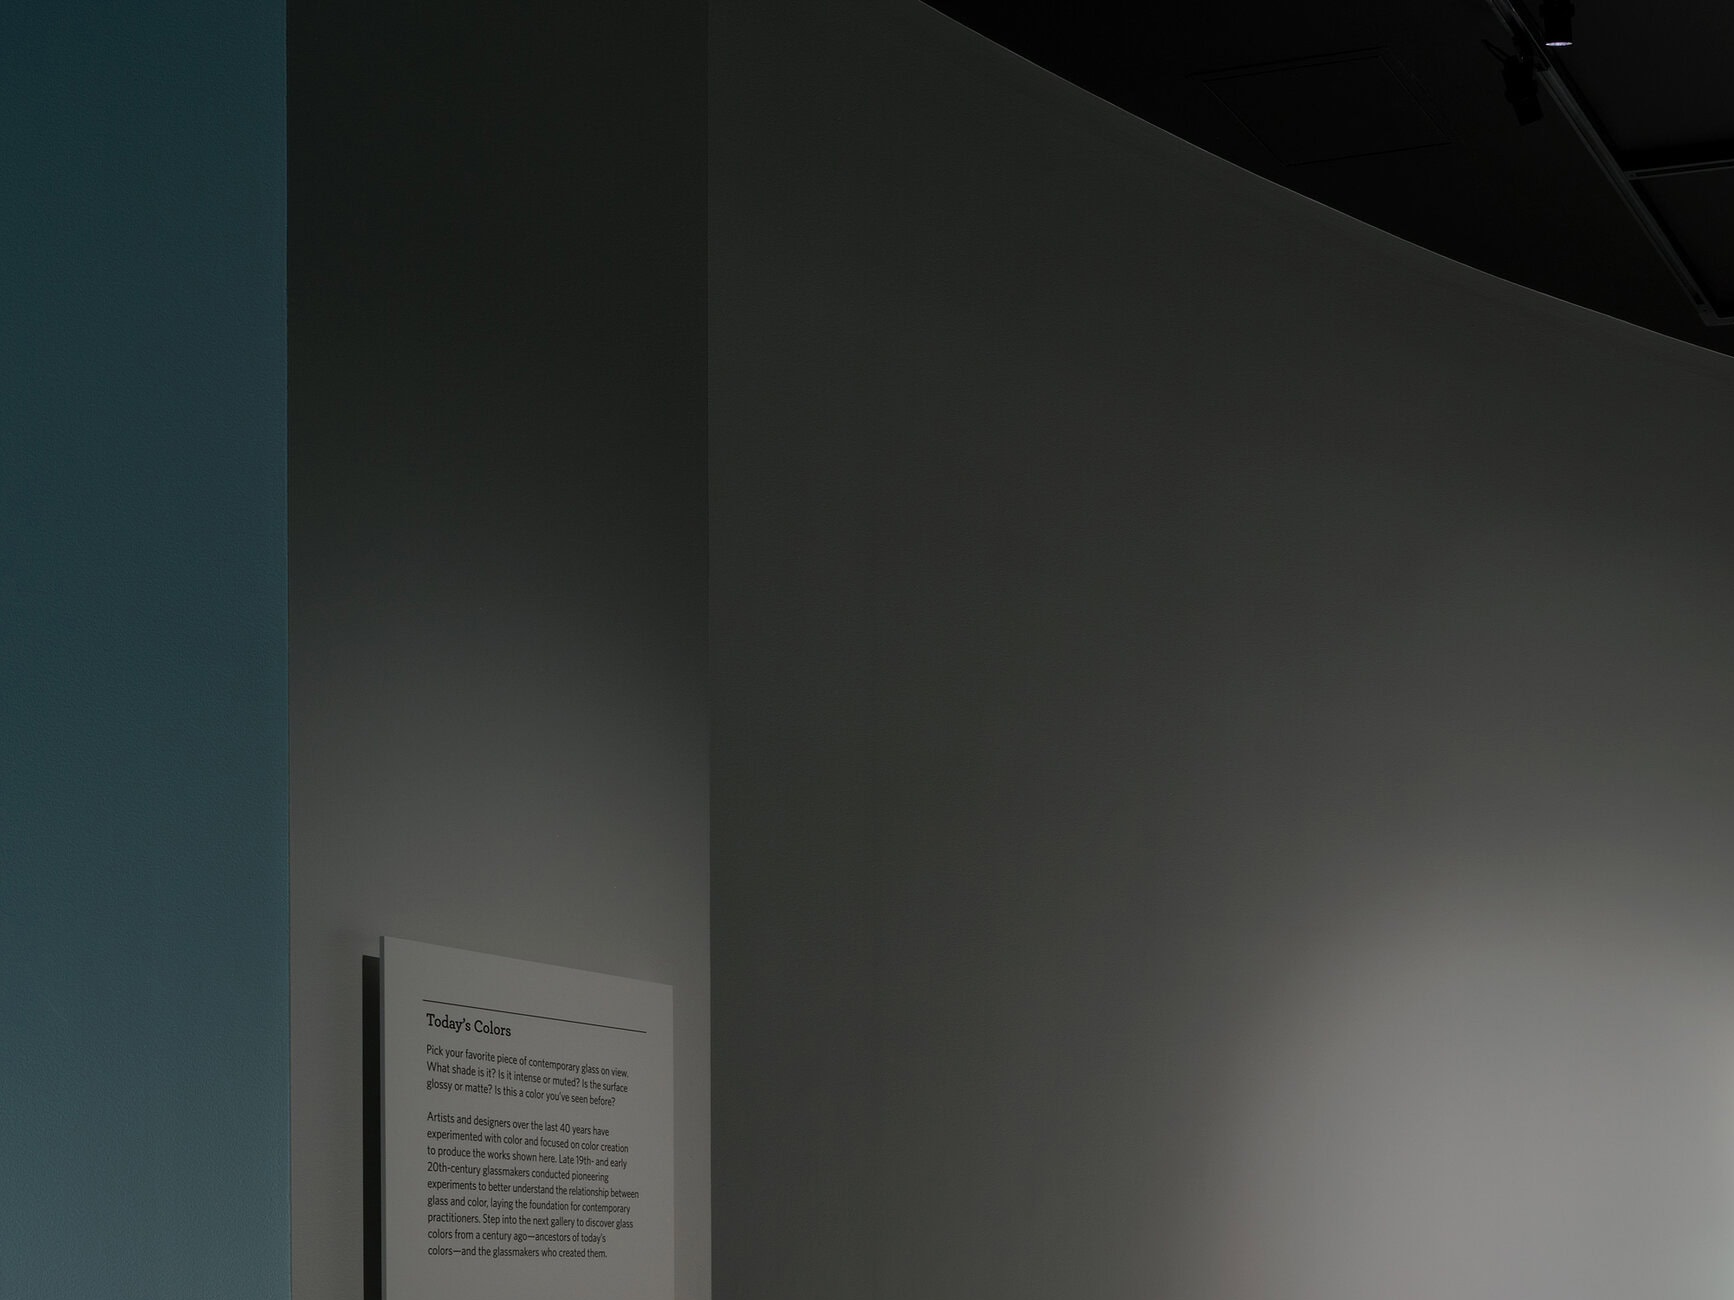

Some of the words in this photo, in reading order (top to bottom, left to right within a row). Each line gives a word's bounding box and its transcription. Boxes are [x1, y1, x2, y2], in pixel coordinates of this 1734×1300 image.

[426, 1012, 471, 1033] Today’s
[473, 1019, 511, 1036] Colors
[426, 1043, 443, 1056] Pick
[445, 1049, 463, 1058] your
[465, 1048, 495, 1062] favorite
[496, 1055, 517, 1064] piece
[518, 1055, 527, 1065] of
[528, 1058, 580, 1073] contemporary
[581, 1063, 599, 1074] glass
[600, 1067, 610, 1075] on
[611, 1069, 629, 1077] view.
[426, 1061, 450, 1073] What
[451, 1064, 476, 1076] shade
[477, 1069, 485, 1077] is
[486, 1067, 496, 1078] it?
[498, 1069, 505, 1079] Is
[506, 1071, 512, 1080] it
[513, 1072, 541, 1083] intense
[542, 1076, 551, 1084] or
[552, 1077, 580, 1087] muted?
[582, 1078, 588, 1088] Is
[589, 1079, 601, 1089] the
[602, 1081, 628, 1092] surface
[426, 1078, 453, 1092] glossy
[454, 1083, 463, 1091] or
[464, 1083, 492, 1094] matte?
[494, 1085, 501, 1095] Is
[503, 1085, 518, 1096] this
[518, 1089, 523, 1097] a
[525, 1088, 544, 1099] color
[545, 1092, 570, 1102] you’ve
[571, 1095, 588, 1103] seen
[589, 1094, 615, 1106] before?
[426, 1111, 455, 1123] Artists
[456, 1114, 471, 1124] and
[473, 1115, 511, 1129] designers
[512, 1121, 529, 1129] over
[530, 1120, 543, 1130] the
[544, 1121, 558, 1132] last
[559, 1123, 570, 1133] 40
[571, 1126, 591, 1135] years
[592, 1125, 609, 1136] have
[426, 1130, 483, 1142] experimented
[484, 1133, 502, 1143] with
[503, 1134, 523, 1144] color
[524, 1136, 538, 1146] and
[540, 1136, 569, 1148] focused
[570, 1141, 580, 1149] on
[580, 1140, 599, 1150] color
[600, 1143, 628, 1152] creation
[426, 1145, 436, 1155] to
[437, 1146, 471, 1157] produce
[472, 1148, 486, 1158] the
[487, 1149, 510, 1160] works
[512, 1150, 537, 1161] shown
[538, 1152, 557, 1163] here.
[558, 1154, 574, 1164] Late
[575, 1155, 594, 1165] 19th-
[595, 1157, 609, 1166] and
[610, 1158, 627, 1169] early
[427, 1161, 481, 1176] 20th-century
[482, 1164, 530, 1177] glassmakers
[531, 1168, 570, 1179] conducted
[571, 1172, 609, 1183] pioneering
[427, 1180, 477, 1190] experiments
[478, 1181, 486, 1191] to
[487, 1181, 511, 1192] better
[512, 1183, 554, 1194] understand
[555, 1185, 567, 1195] the
[568, 1185, 609, 1198] relationship
[610, 1187, 639, 1198] between
[426, 1194, 448, 1207] glass
[450, 1196, 465, 1206] and
[467, 1196, 488, 1208] color,
[490, 1197, 513, 1210] laying
[514, 1198, 527, 1209] the
[529, 1199, 569, 1210] foundation
[570, 1201, 580, 1211] for
[581, 1203, 630, 1215] contemporary
[427, 1212, 481, 1223] practitioners.
[482, 1213, 500, 1225] Step
[501, 1215, 517, 1224] into
[518, 1214, 531, 1225] the
[532, 1216, 549, 1225] next
[550, 1216, 575, 1228] gallery
[576, 1218, 584, 1226] to
[585, 1217, 614, 1227] discover
[615, 1218, 633, 1229] glass
[427, 1228, 453, 1239] colors
[454, 1228, 474, 1239] from
[482, 1230, 512, 1242] century
[571, 1232, 579, 1242] of
[580, 1232, 606, 1244] today’s
[478, 1245, 491, 1256] the
[492, 1246, 539, 1258] glassmakers
[540, 1247, 557, 1257] who
[558, 1248, 585, 1257] created
[587, 1248, 607, 1257] them.
